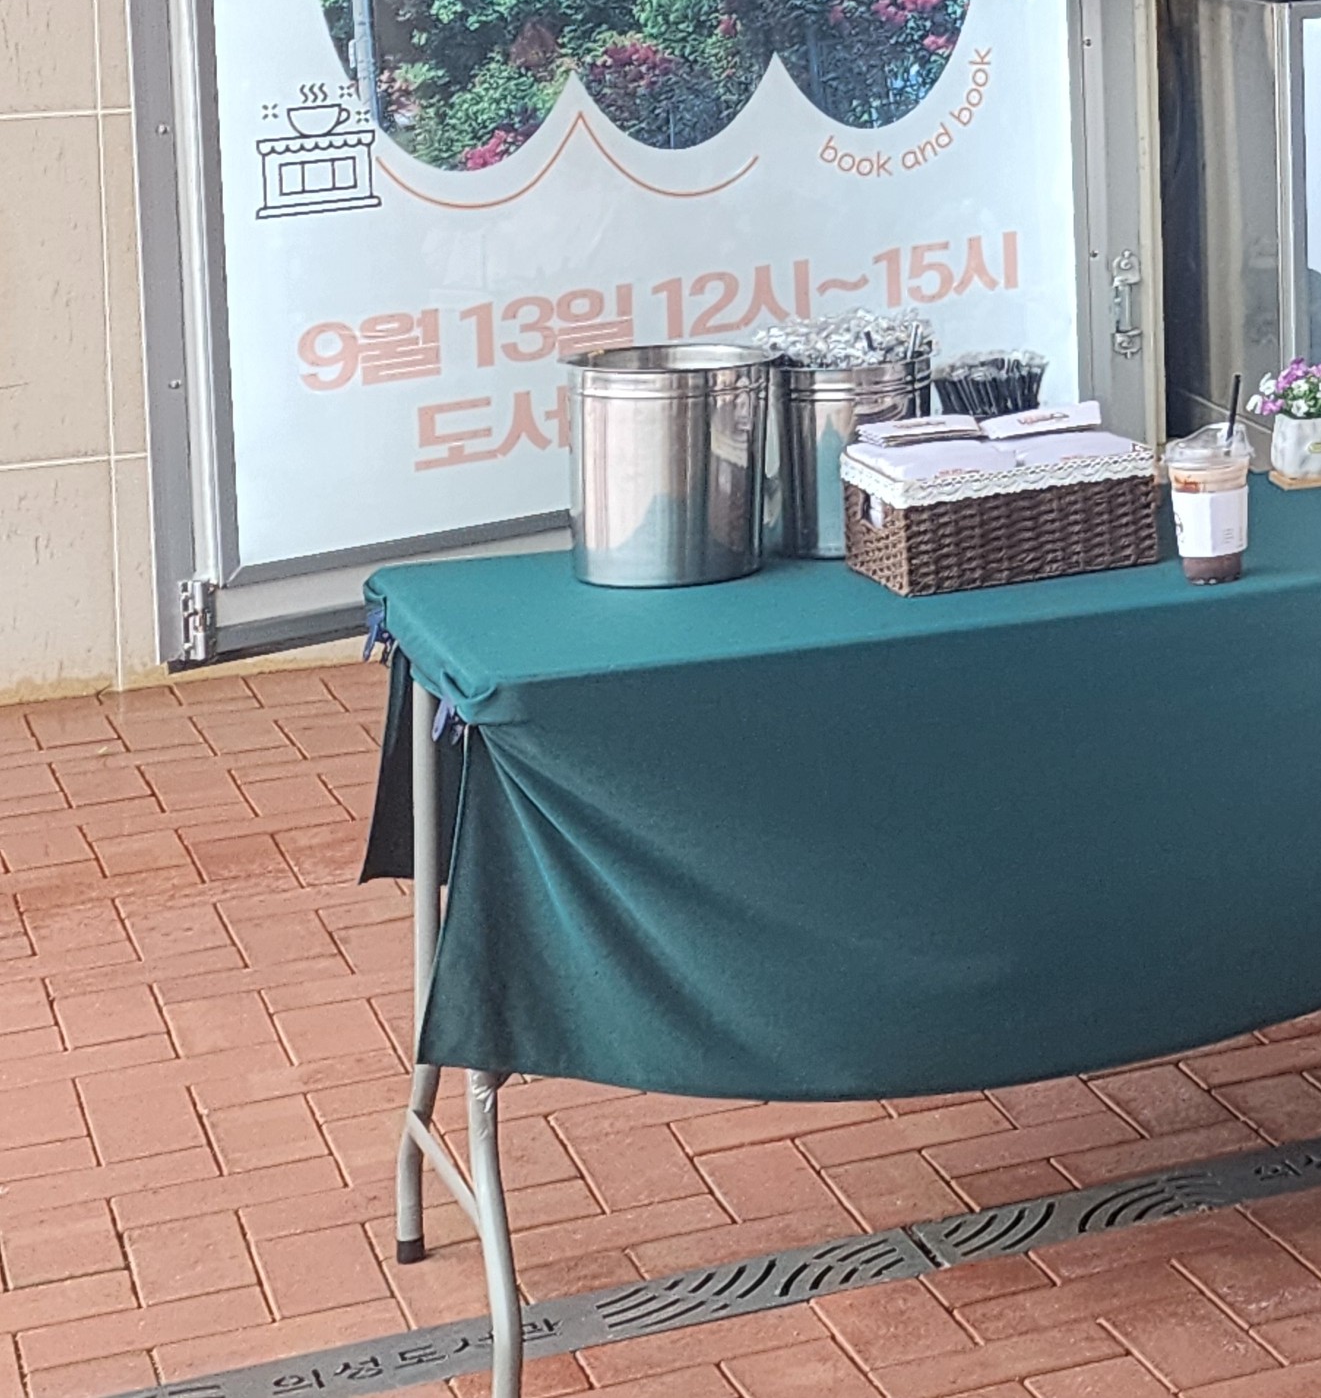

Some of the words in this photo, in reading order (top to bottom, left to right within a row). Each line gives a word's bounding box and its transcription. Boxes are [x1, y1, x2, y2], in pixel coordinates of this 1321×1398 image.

[819, 134, 894, 178] book
[901, 122, 954, 171] and
[949, 47, 993, 128] book
[297, 310, 442, 392] 9월
[461, 283, 634, 370] 13일
[651, 230, 1020, 340] 12시~15시
[414, 387, 572, 472] 도서
